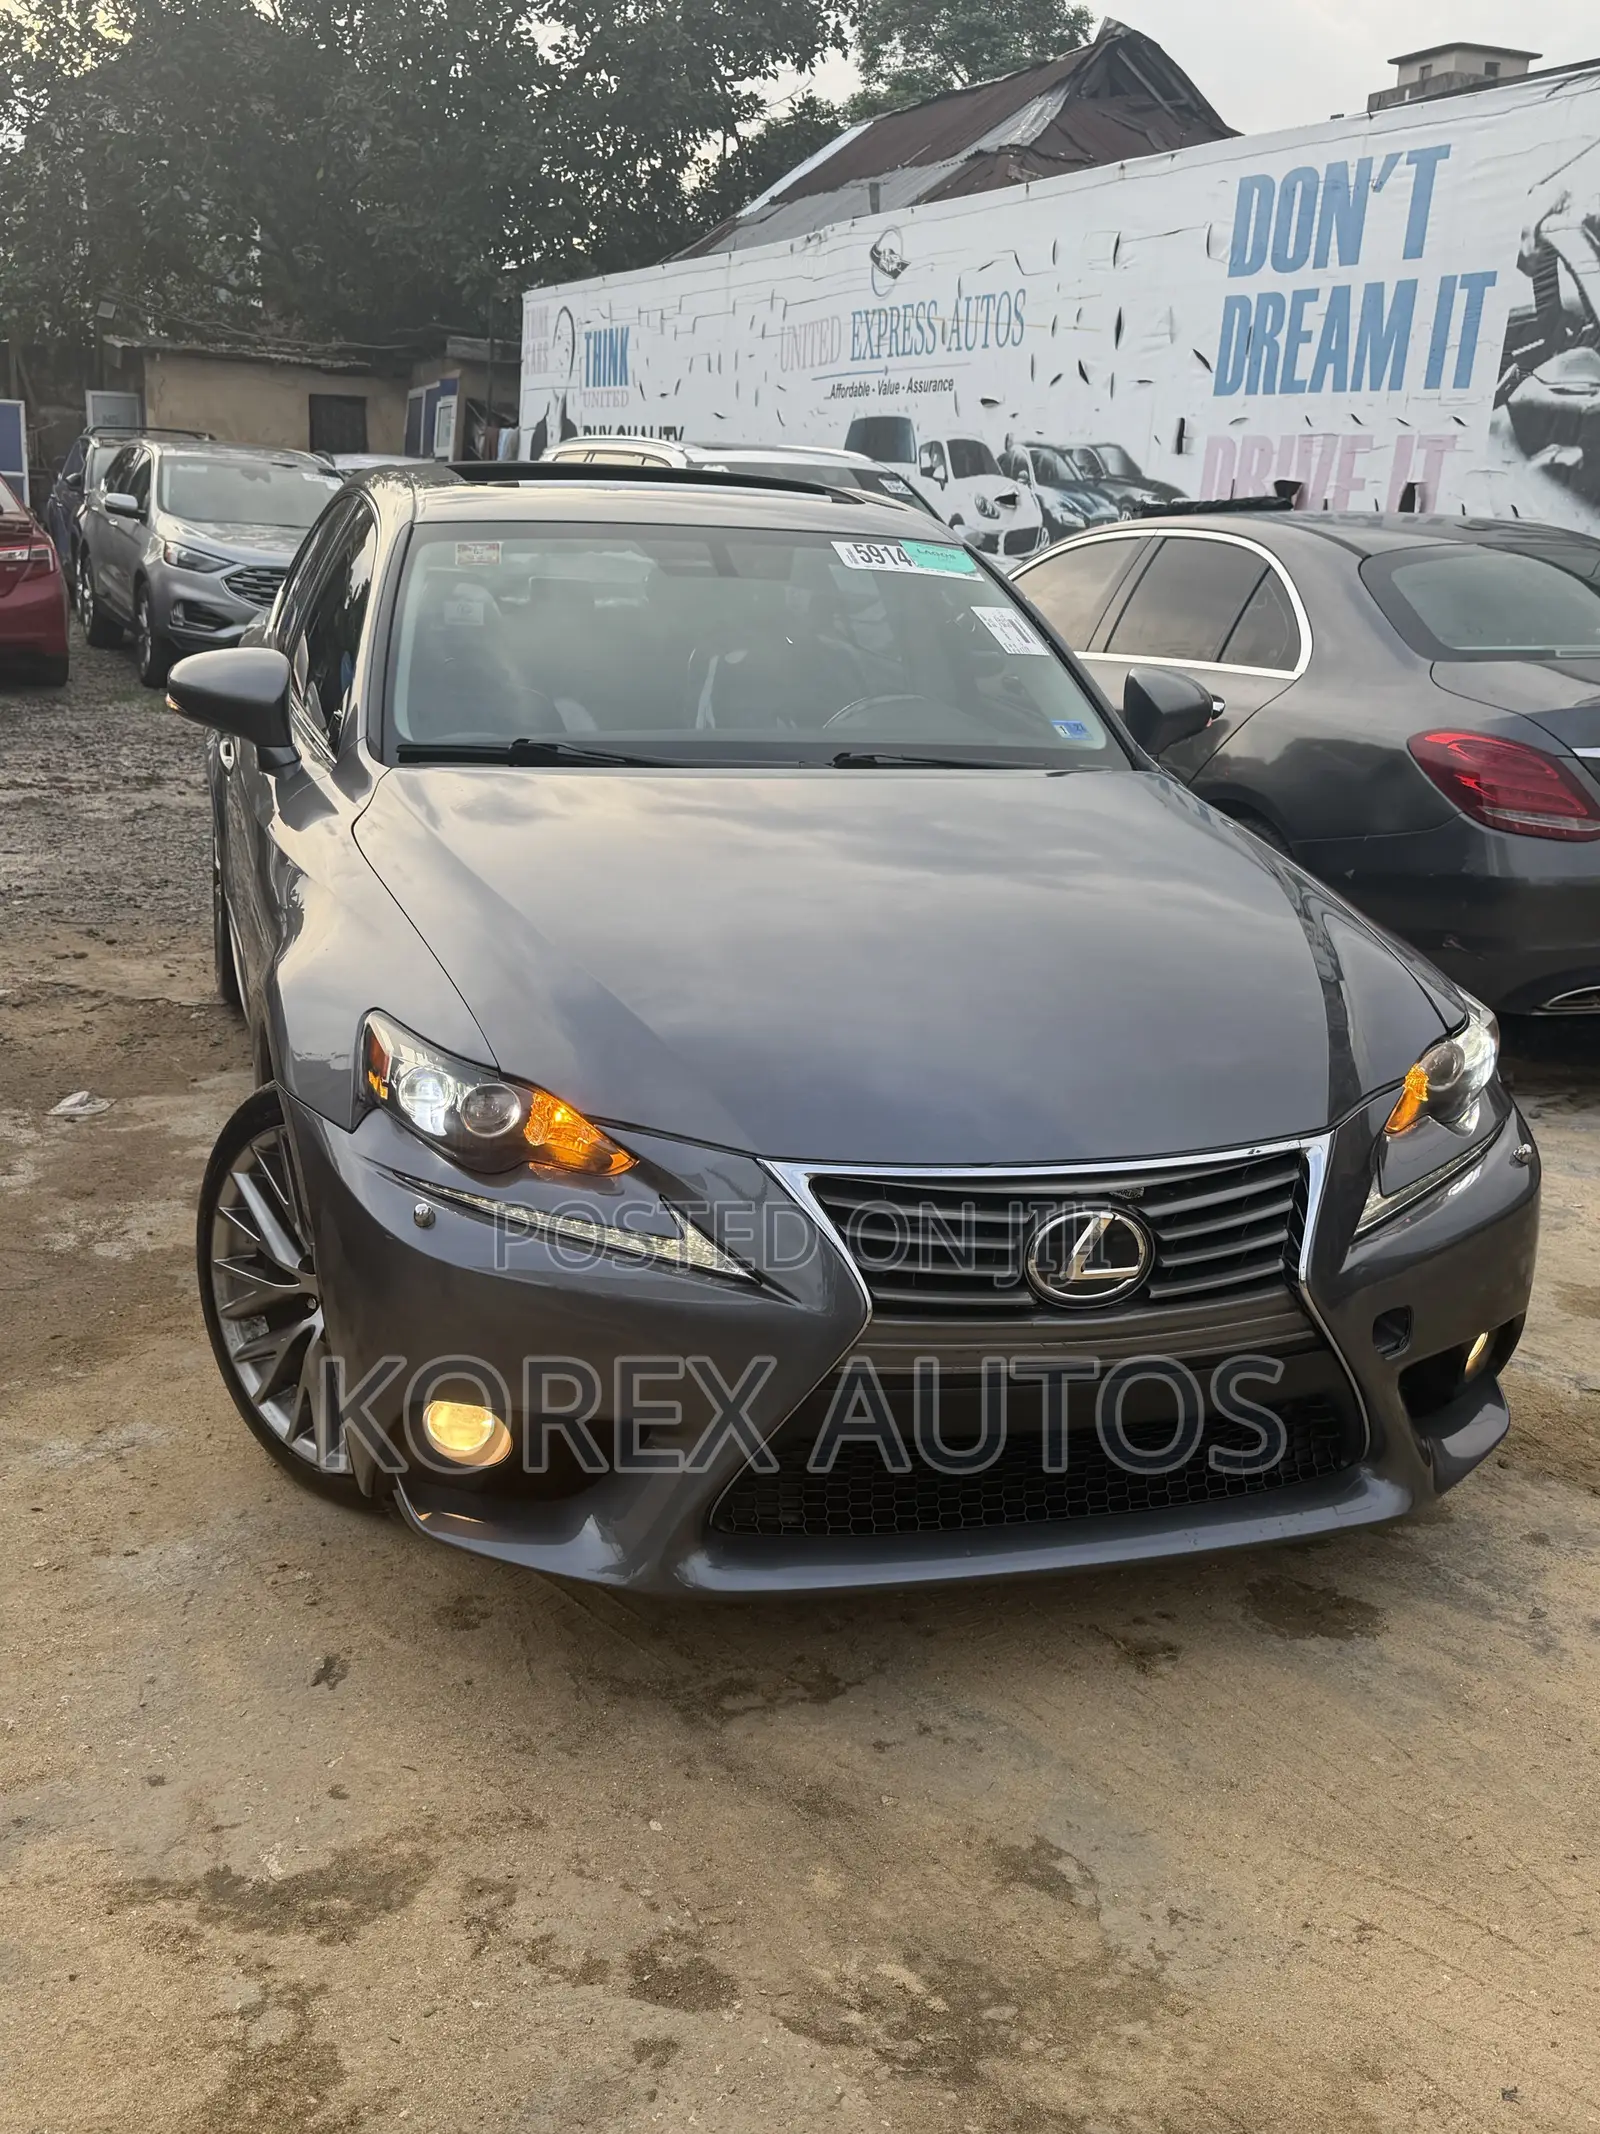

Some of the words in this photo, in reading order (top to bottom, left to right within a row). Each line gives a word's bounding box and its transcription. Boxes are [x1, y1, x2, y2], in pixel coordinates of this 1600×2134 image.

[1227, 144, 1451, 278] DON'T
[584, 326, 630, 388] THINK
[780, 315, 842, 373] UNITED
[850, 299, 938, 361] EXPRESS
[946, 288, 1026, 352] AUTOS
[1212, 278, 1419, 397] DREAM
[1423, 271, 1497, 389] IT
[583, 389, 630, 409] UNITED
[830, 381, 870, 399] Affordable
[877, 379, 900, 396] Value
[906, 377, 954, 394] Assurance
[1199, 433, 1375, 512] DRIVE
[852, 543, 913, 567] 5914
